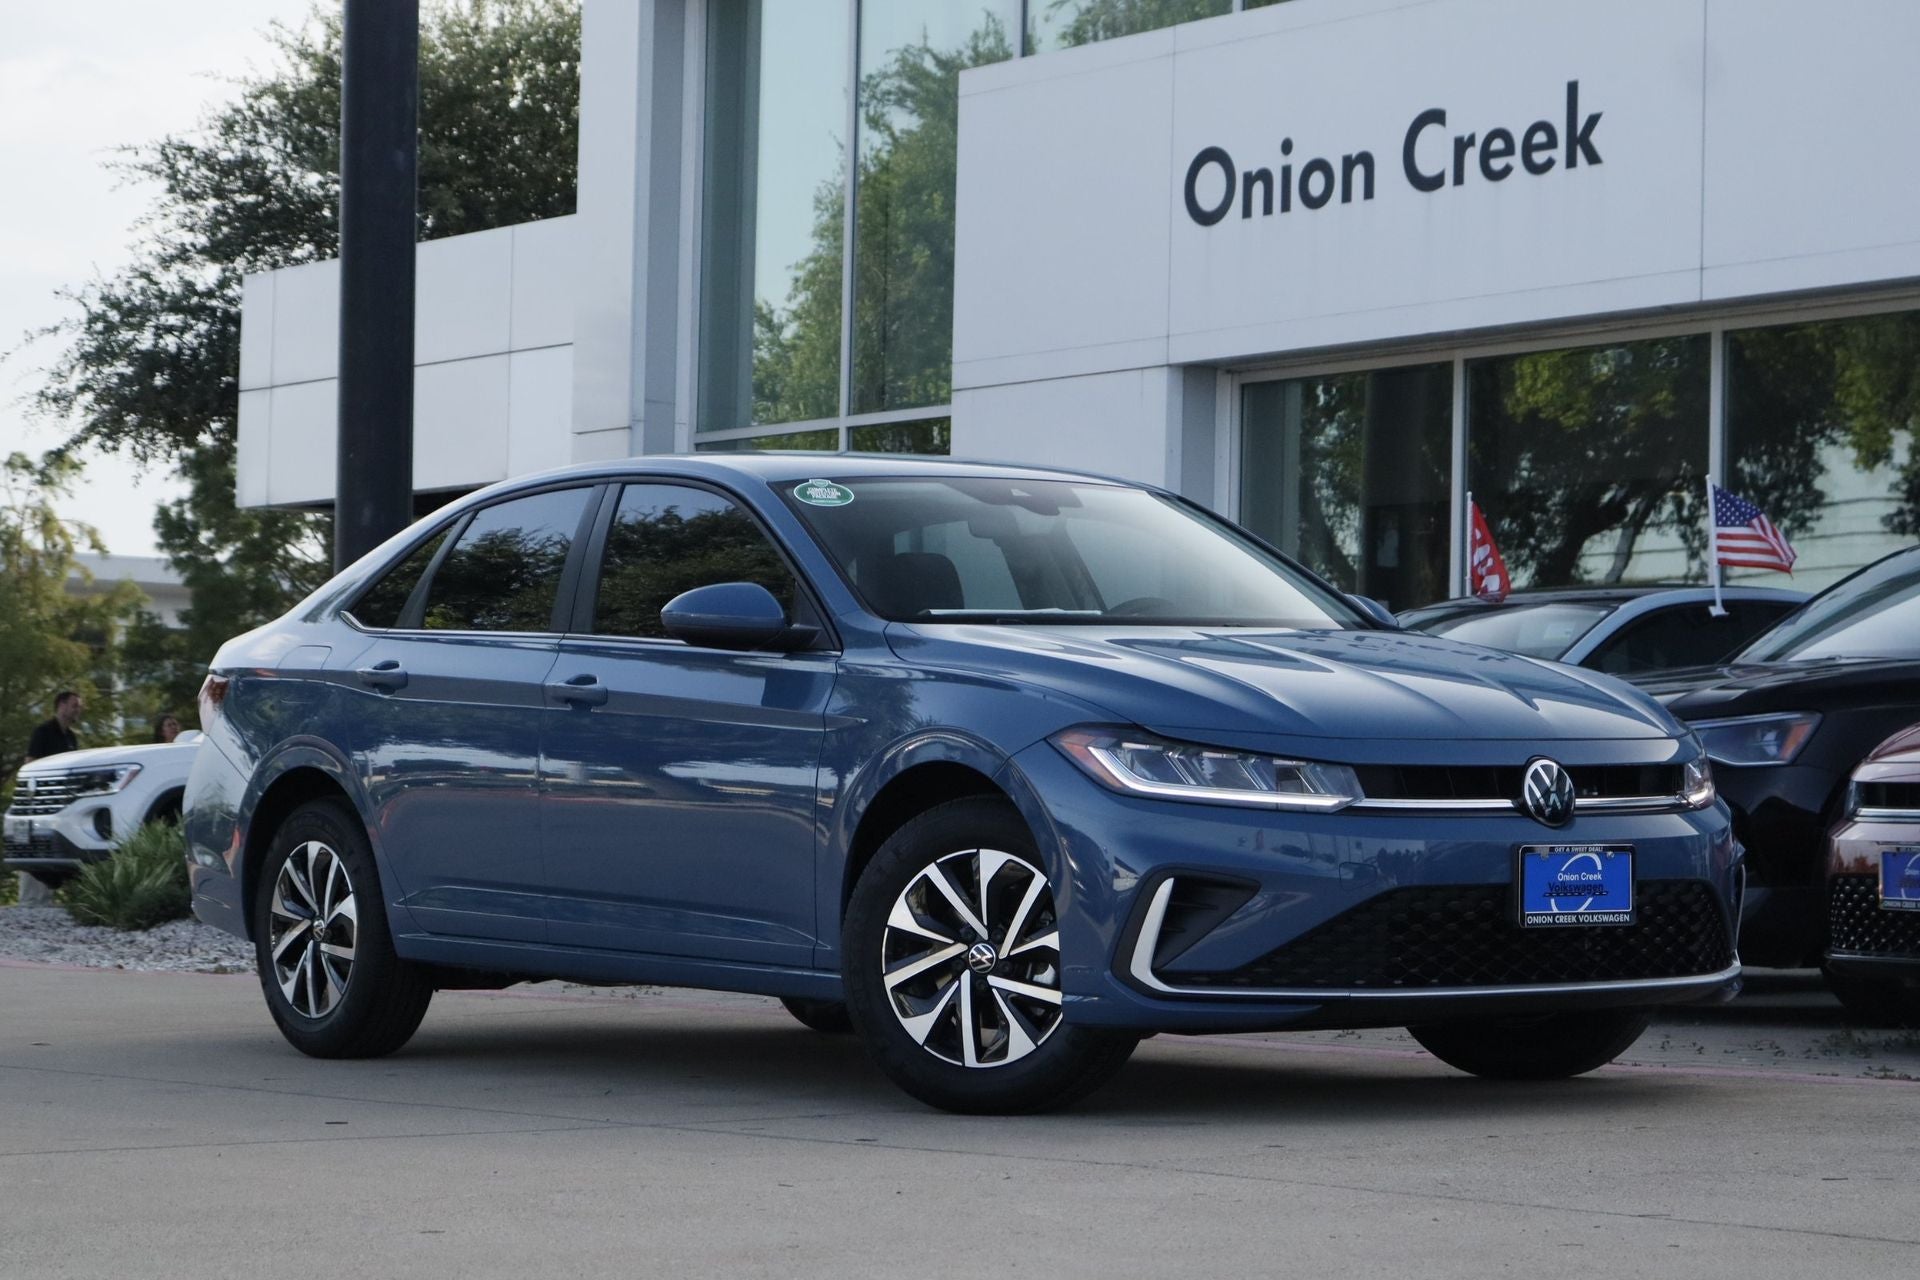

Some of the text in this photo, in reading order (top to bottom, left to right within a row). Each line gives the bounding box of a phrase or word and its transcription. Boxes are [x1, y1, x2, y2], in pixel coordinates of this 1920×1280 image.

[1184, 79, 1604, 227] Onion Creek
[1557, 871, 1602, 881] Onion Creek
[1548, 882, 1604, 895] Volkswagen
[1527, 914, 1630, 924] ONION CREEK VOLKSWAGEN
